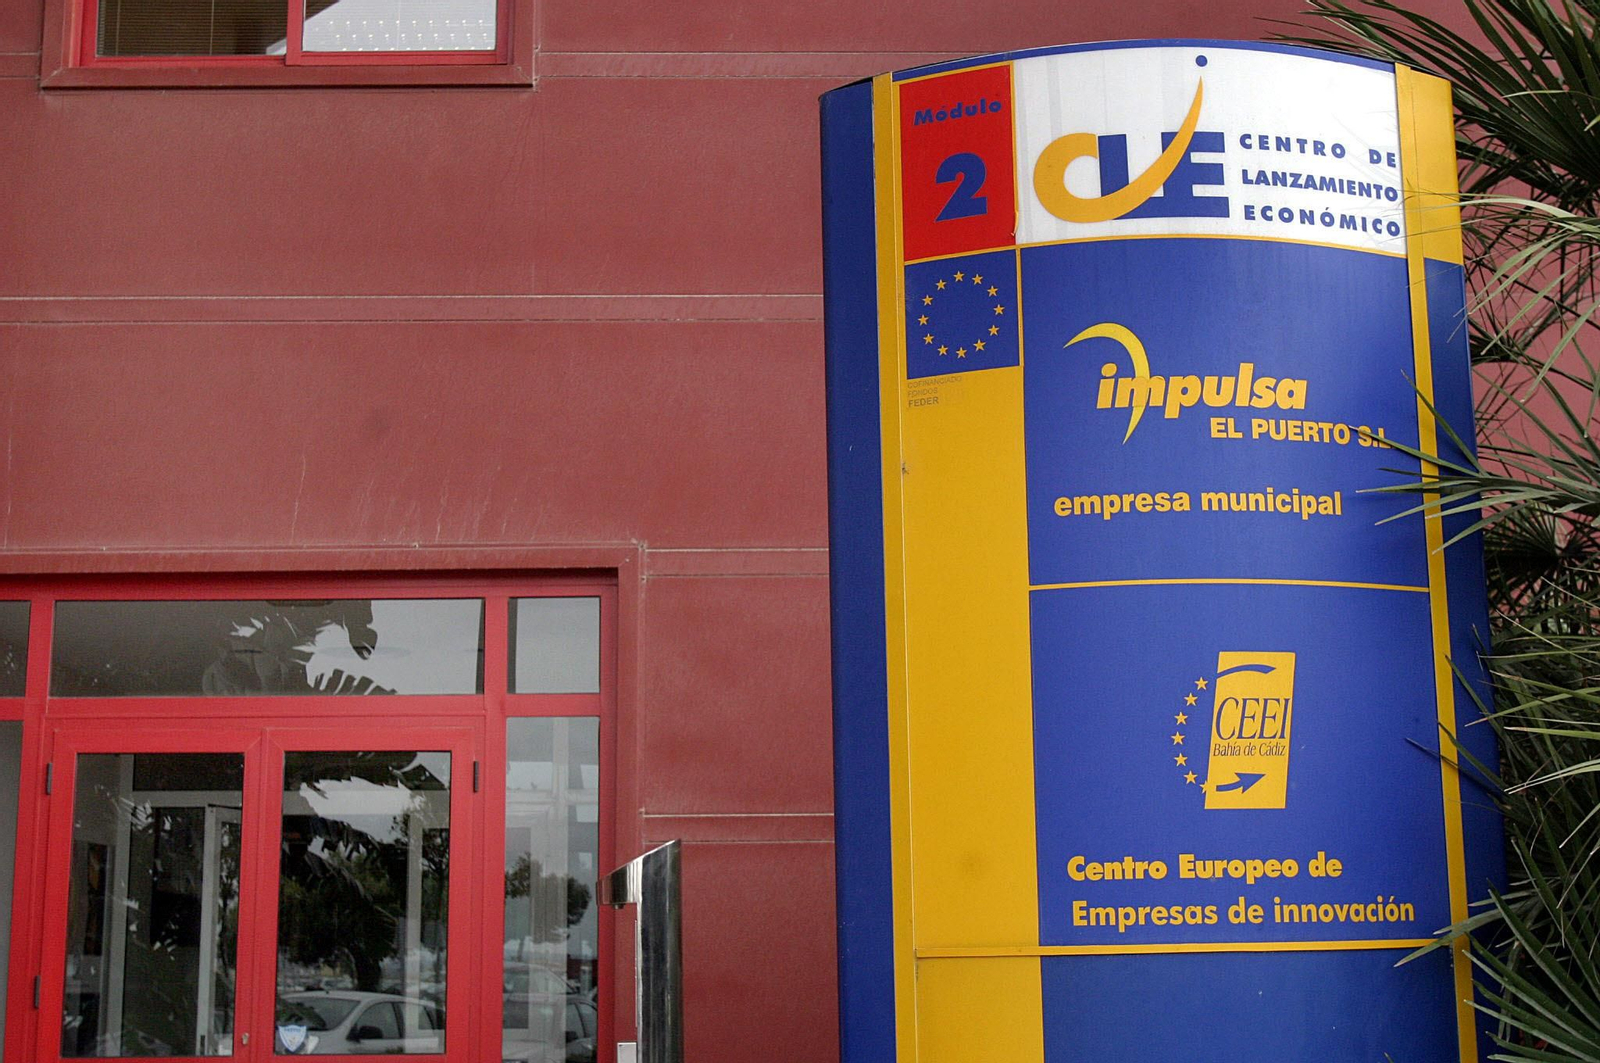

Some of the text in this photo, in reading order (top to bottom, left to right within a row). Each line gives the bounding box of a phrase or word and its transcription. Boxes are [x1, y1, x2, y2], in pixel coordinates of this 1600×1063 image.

[914, 98, 1001, 126] Módulo
[1239, 133, 1398, 168] CENTRO DE
[935, 152, 988, 222] 2
[1242, 169, 1399, 202] LANZAMIENTO
[1244, 202, 1401, 237] ECONÓMICO
[907, 387, 938, 398] FONDOS
[908, 396, 939, 408] FEDER
[1096, 362, 1307, 419] impulsa
[1210, 417, 1394, 449] EL PUERTO S.L
[1054, 487, 1342, 520] empresa municipal
[1215, 696, 1291, 741] CEEI
[1213, 741, 1286, 757] Bahía de Cádiz
[1067, 851, 1343, 885] Centro Europeo de
[1072, 895, 1415, 933] Empresas de innovación
